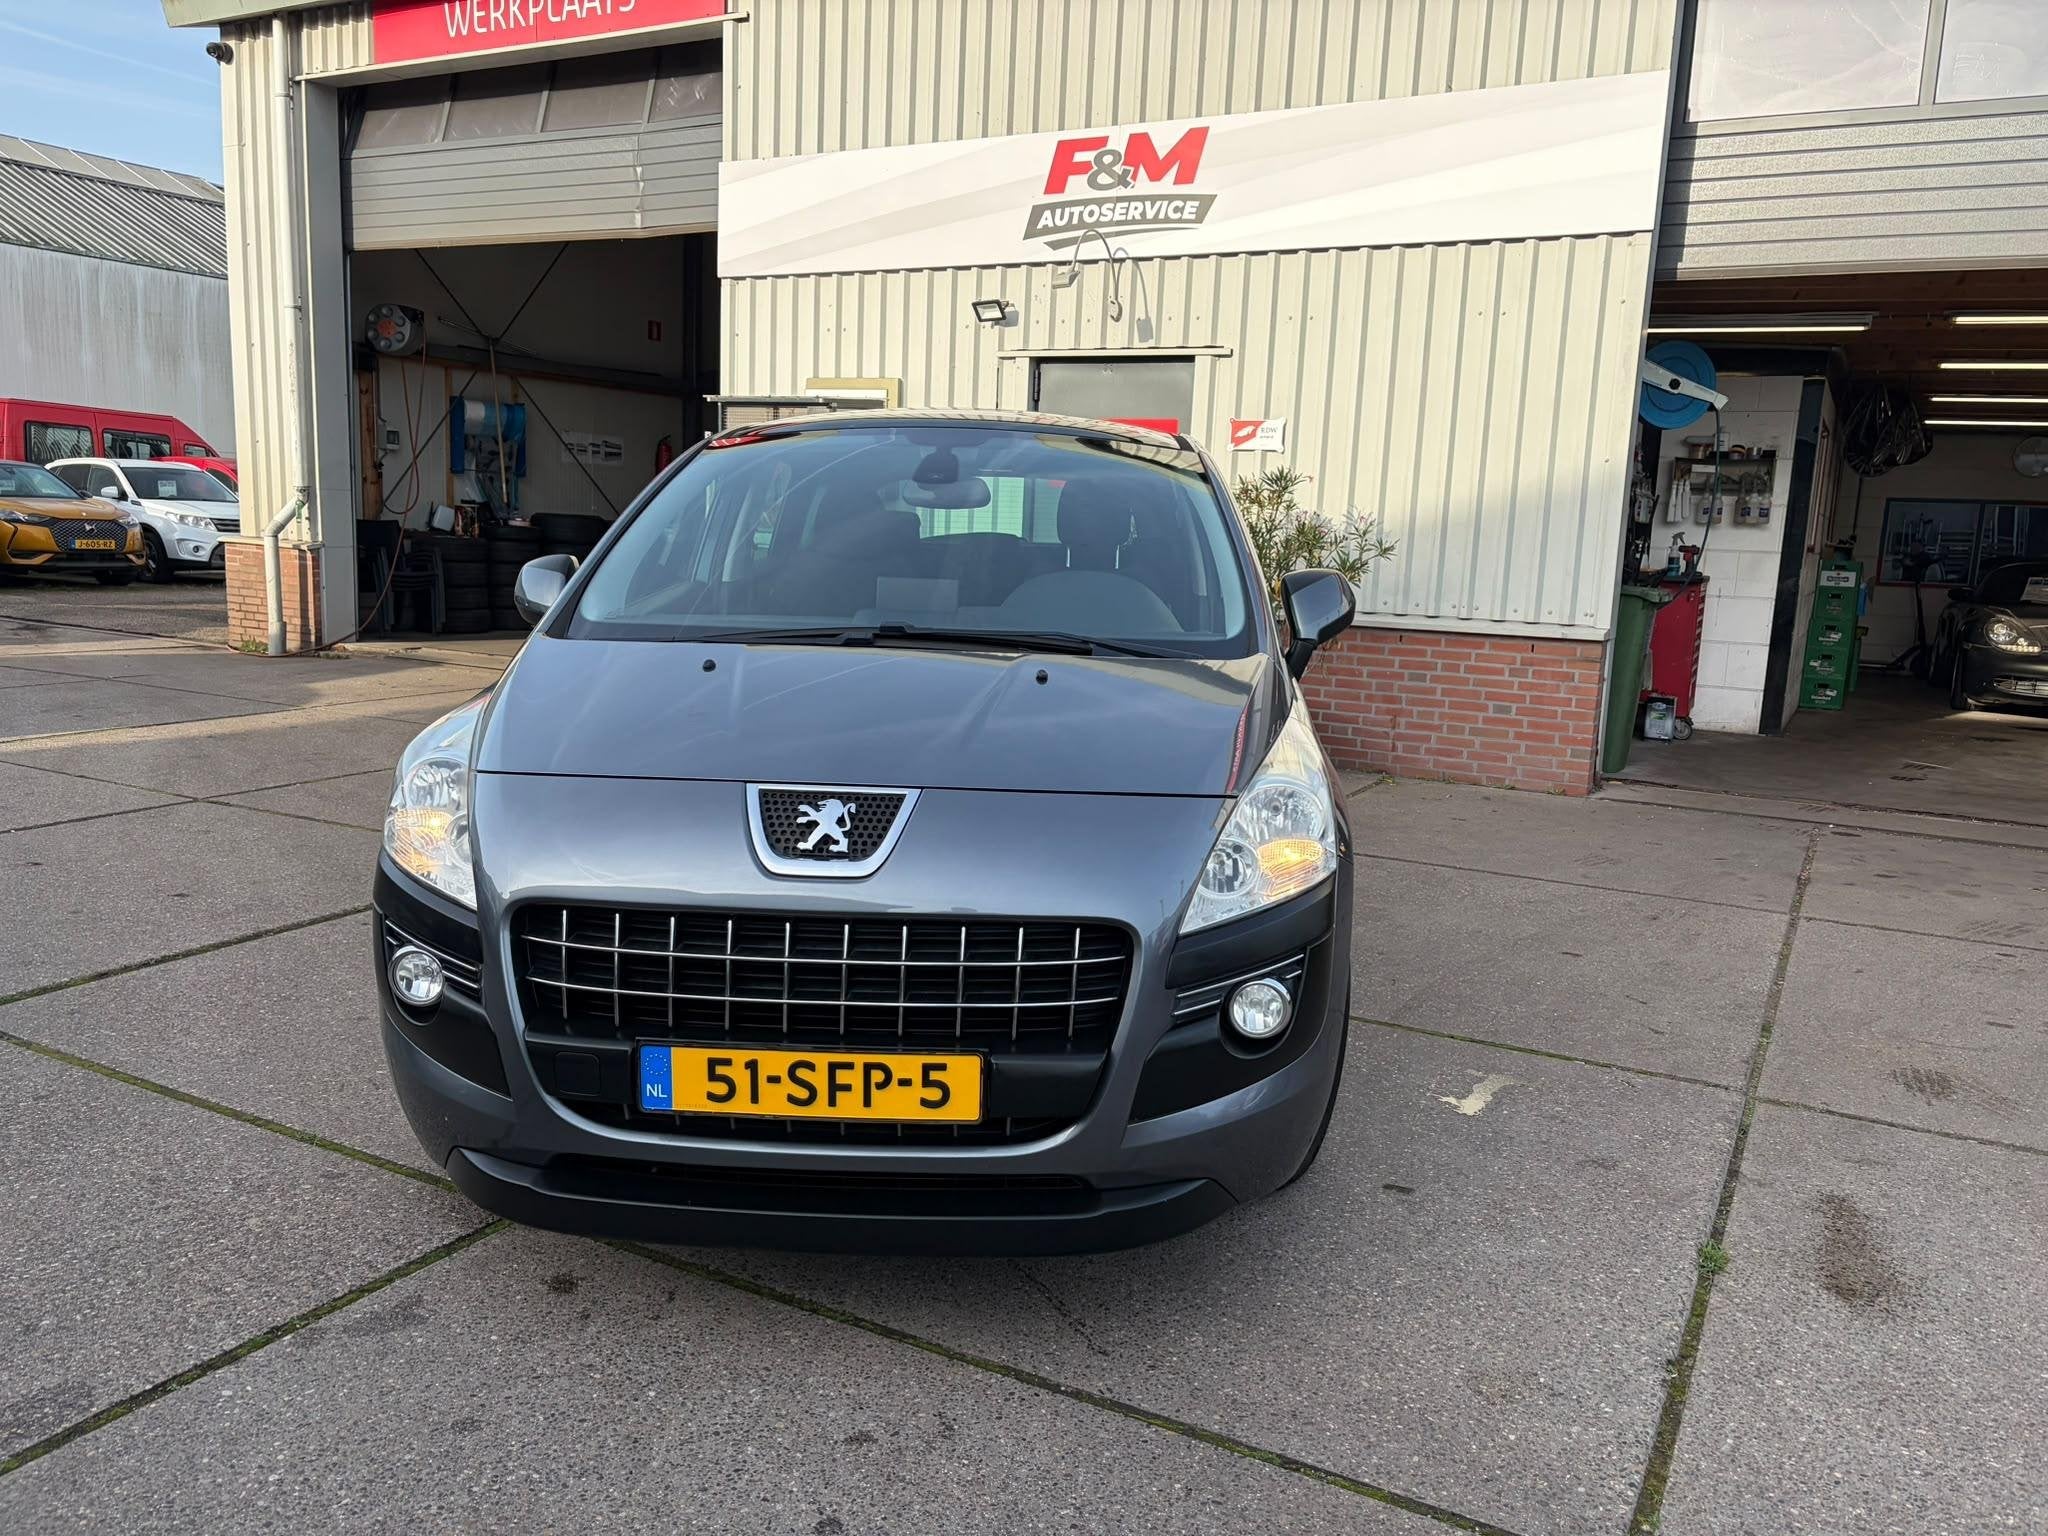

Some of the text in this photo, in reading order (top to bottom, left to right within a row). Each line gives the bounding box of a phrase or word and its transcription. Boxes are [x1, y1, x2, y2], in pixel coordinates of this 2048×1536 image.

[1043, 126, 1210, 195] F&M
[1036, 200, 1200, 229] AUTOSERVICE
[646, 1083, 668, 1098] NL
[706, 1057, 951, 1109] 51-SFP-5
